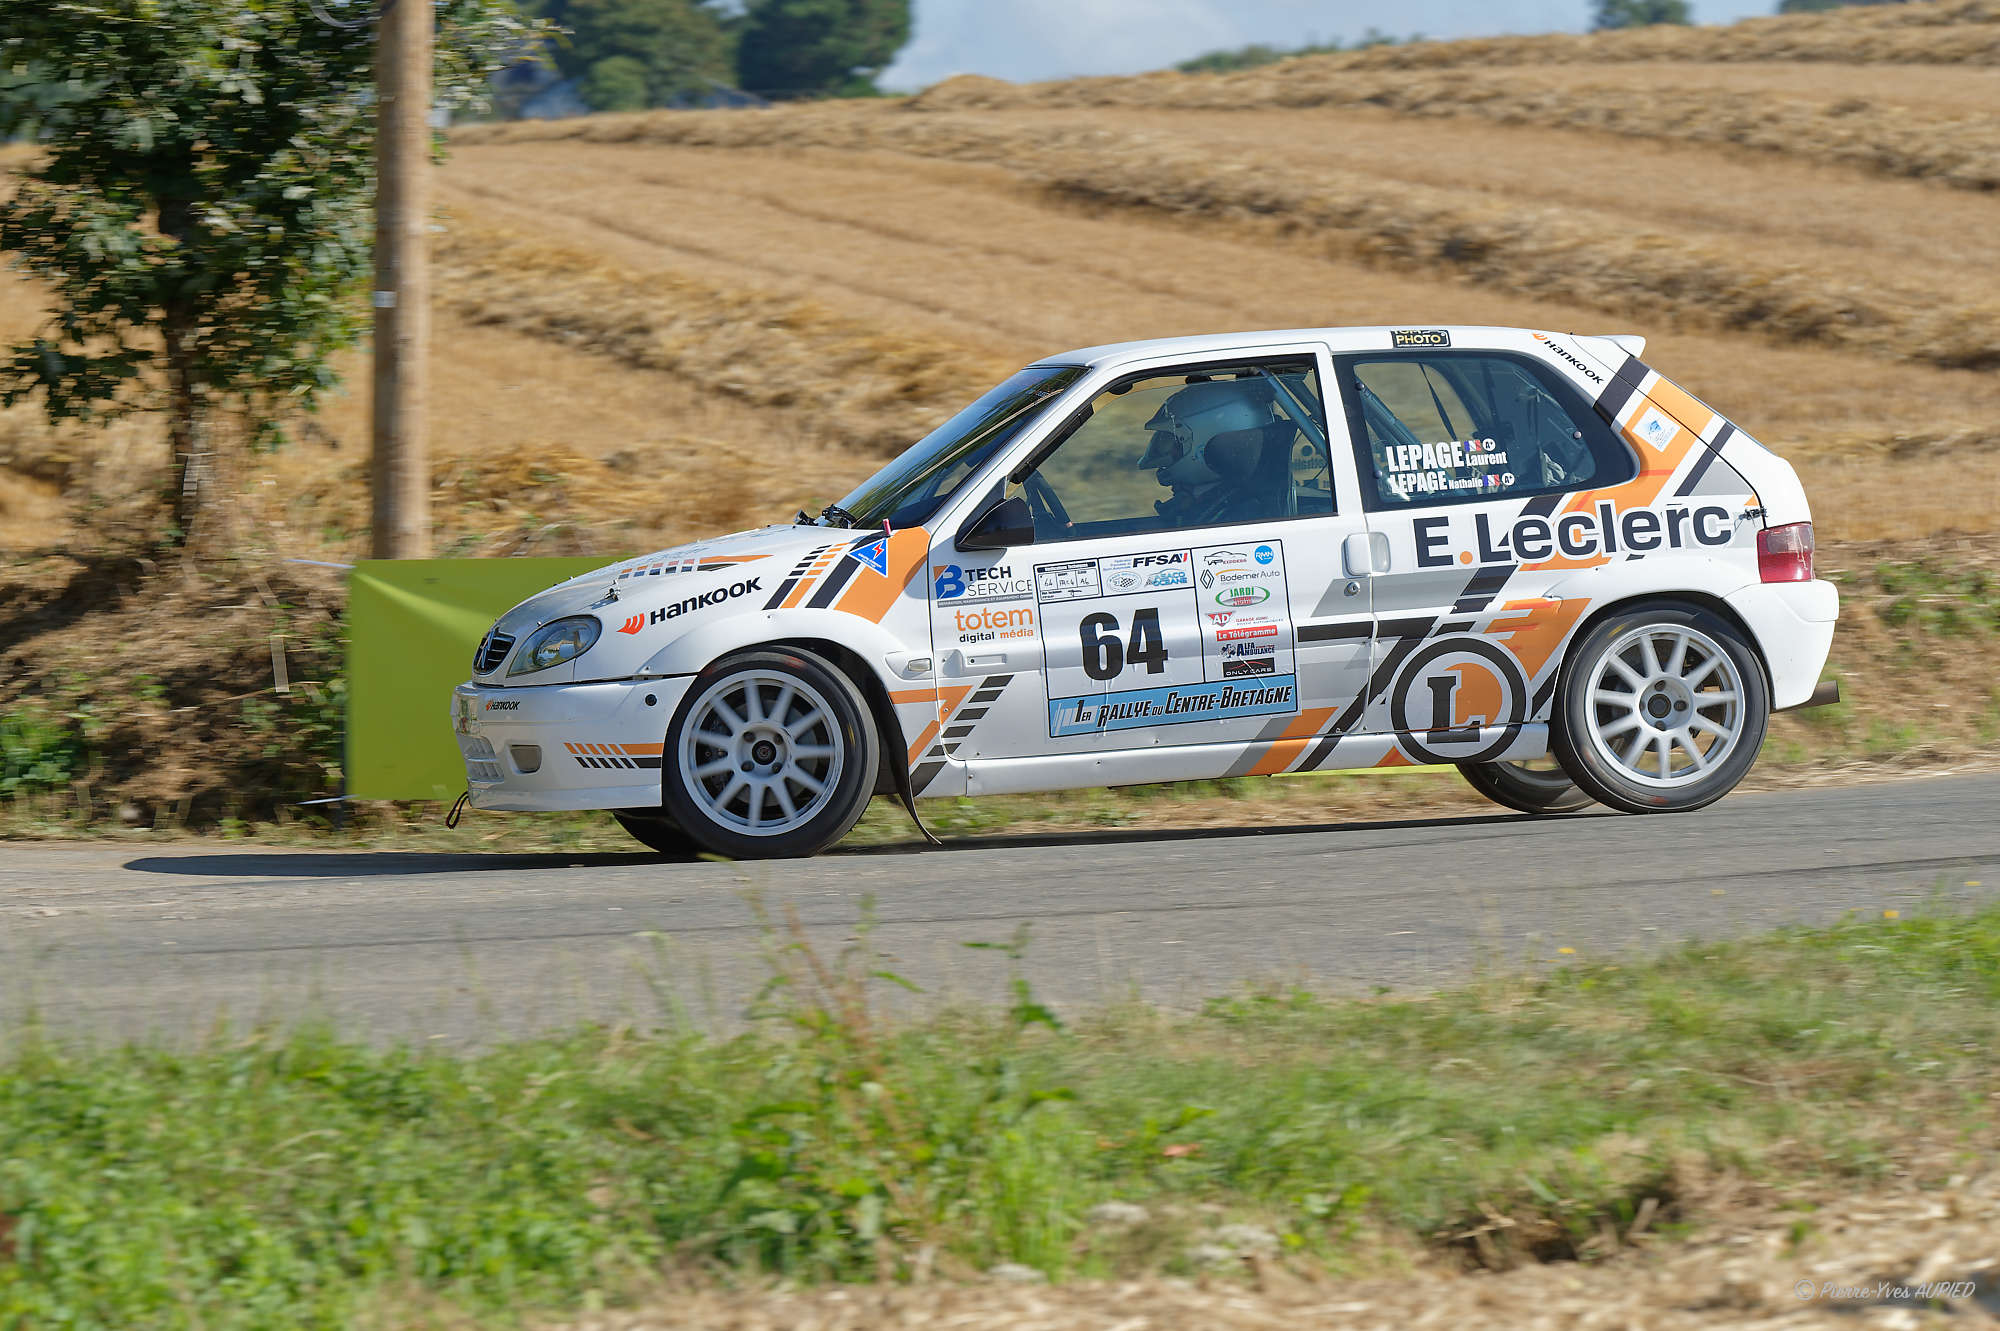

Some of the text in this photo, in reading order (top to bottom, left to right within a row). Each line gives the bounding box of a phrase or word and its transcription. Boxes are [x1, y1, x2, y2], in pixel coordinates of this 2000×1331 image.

[1395, 334, 1442, 345] PHOTO
[1385, 441, 1465, 473] LEPAGE
[1465, 451, 1508, 466] Laurent
[1388, 470, 1449, 494] LEPAGE
[1448, 478, 1483, 490] Nathalie
[1133, 553, 1183, 568] FFSA
[964, 565, 1012, 582] TECH
[954, 607, 1034, 632] totem
[1212, 613, 1230, 625] AD
[959, 629, 1034, 644] digital média
[1218, 632, 1228, 640] Le
[1079, 607, 1169, 681] 64
[1225, 668, 1249, 676] ONLY
[1096, 700, 1152, 728] RALLYE
